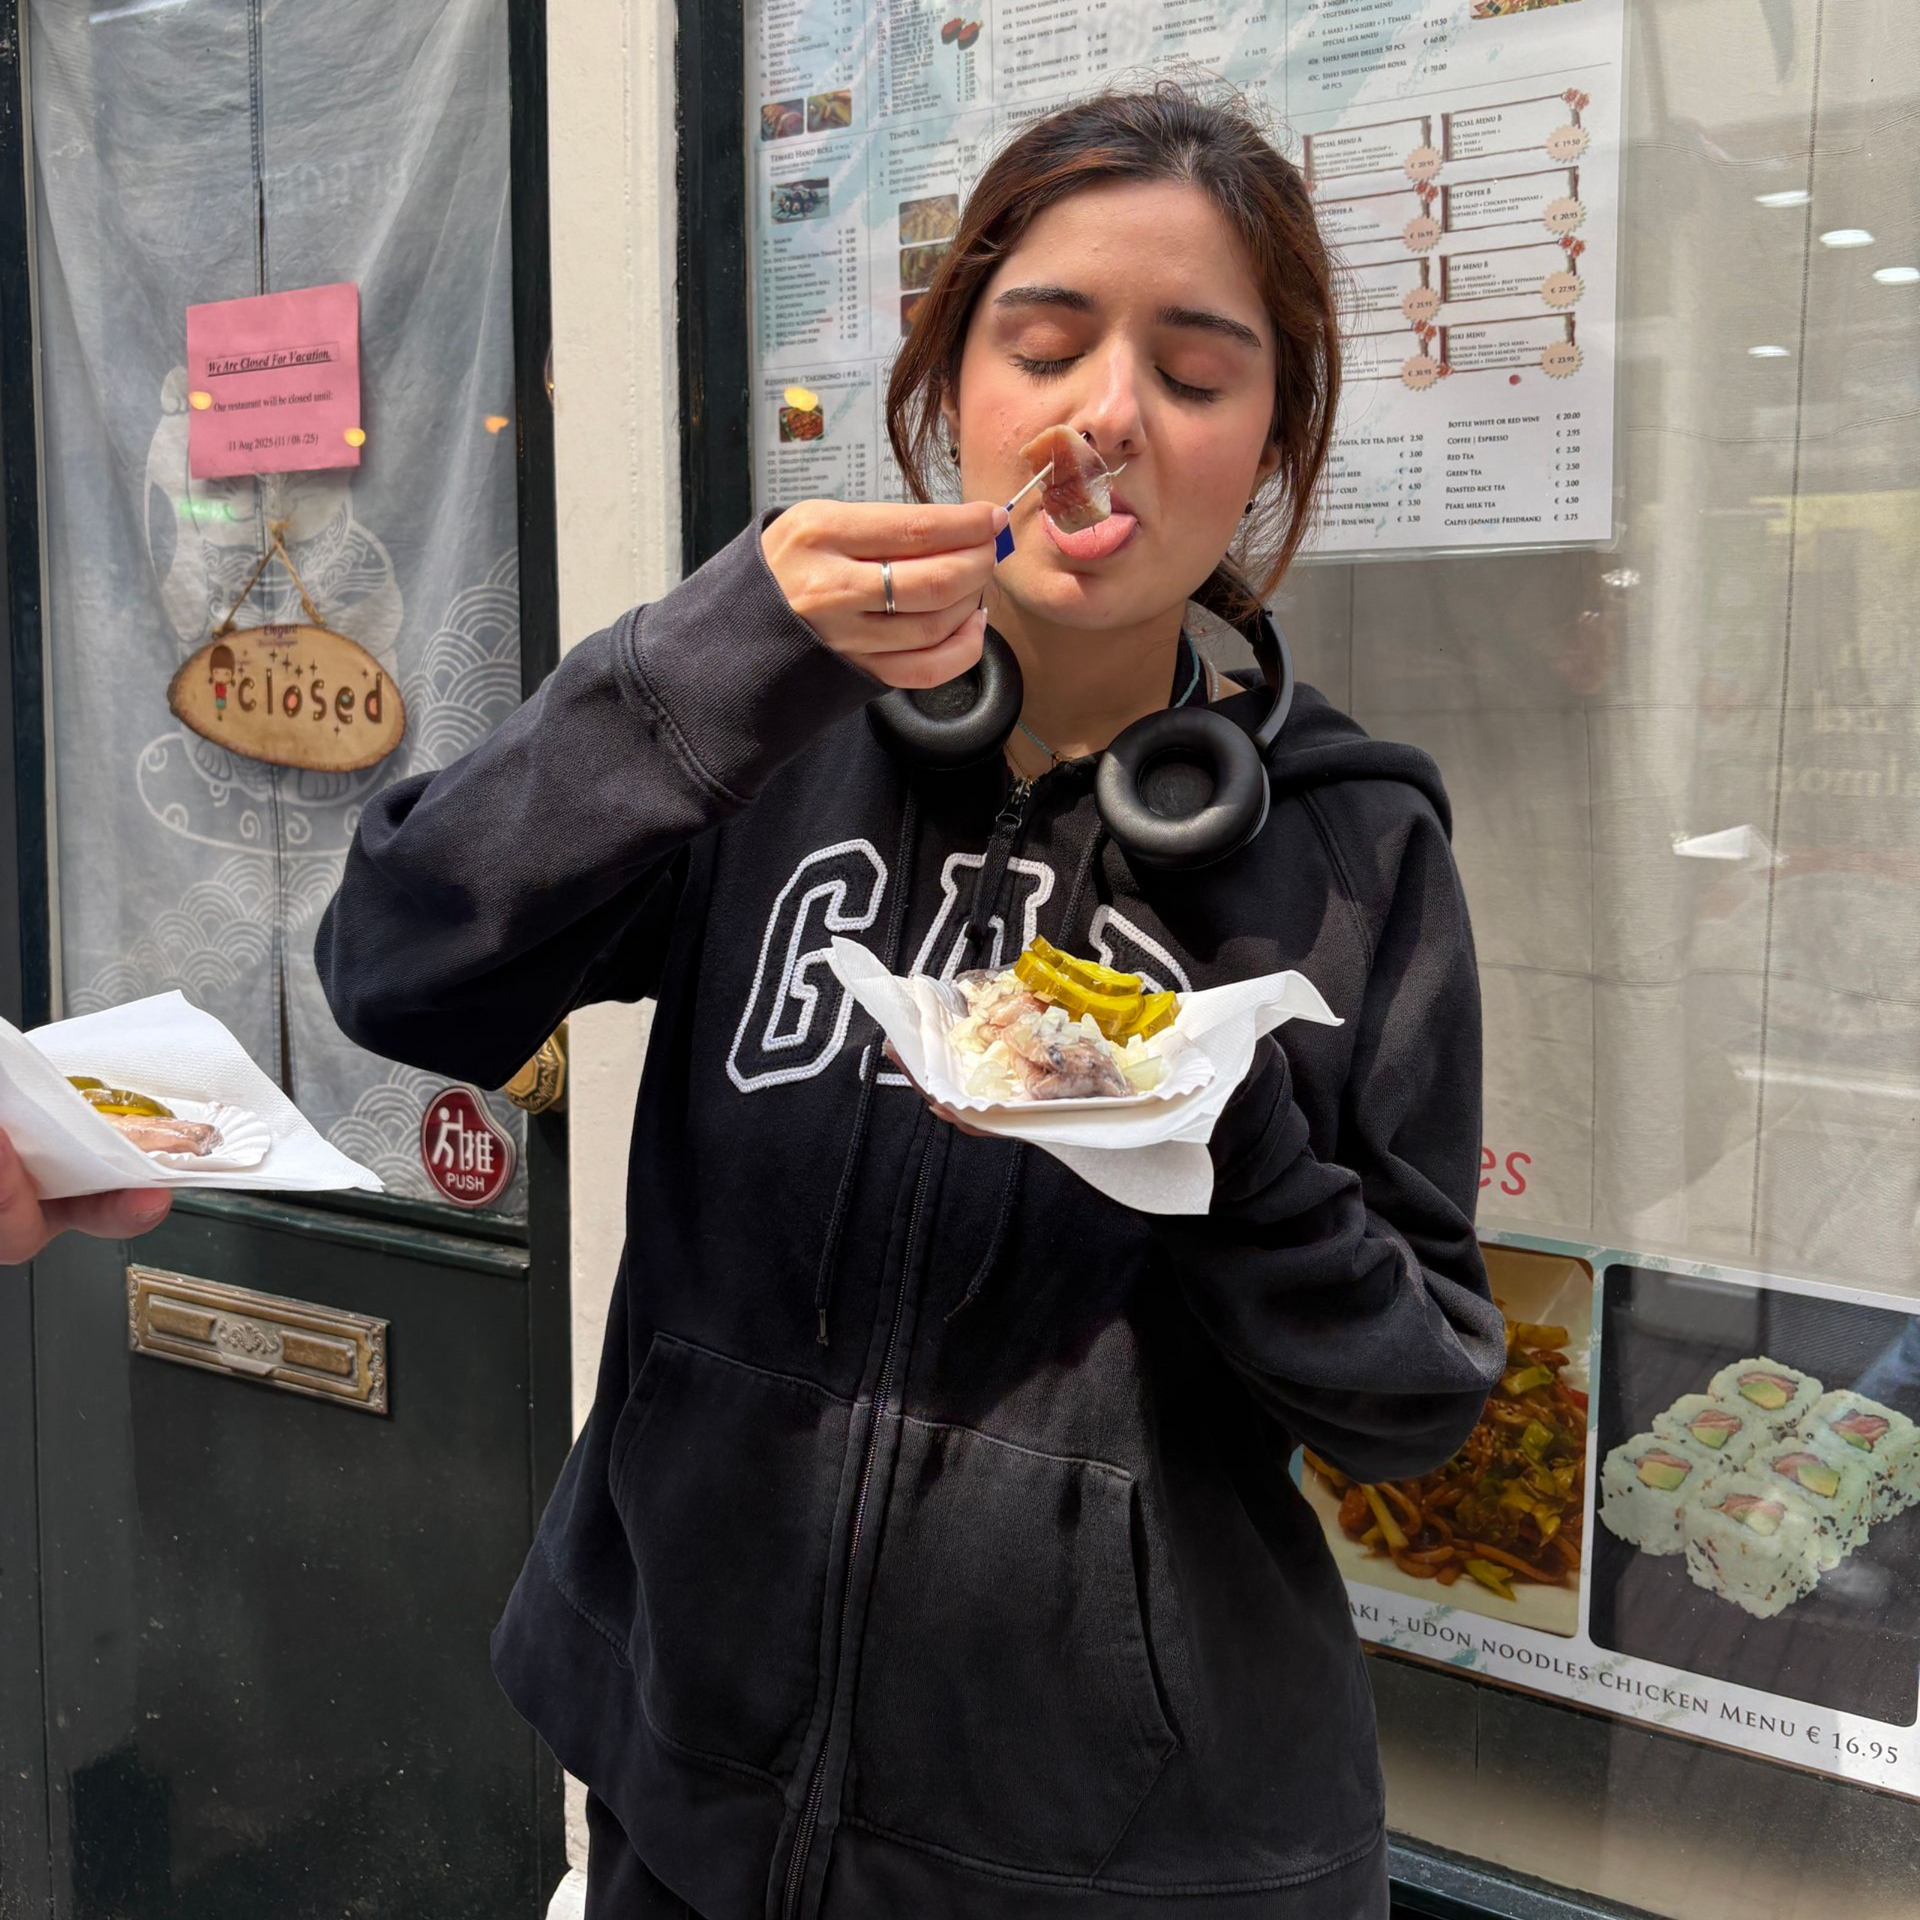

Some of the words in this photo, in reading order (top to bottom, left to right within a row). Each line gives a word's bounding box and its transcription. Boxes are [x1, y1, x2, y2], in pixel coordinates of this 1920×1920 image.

[1475, 117, 1496, 125] MENU
[1558, 285, 1576, 294] 27.95
[1466, 331, 1486, 339] MENU
[207, 361, 222, 374] We
[223, 359, 237, 372] Are
[240, 355, 269, 370] Closed
[272, 354, 286, 366] For
[288, 349, 331, 363] Vacation.
[214, 402, 226, 413] Our
[228, 399, 261, 410] restaurant
[263, 396, 277, 407] will
[278, 396, 287, 405] be
[288, 394, 312, 404] closed
[313, 391, 333, 402] until:
[1473, 419, 1495, 427] WHITE
[1563, 412, 1580, 420] 20.00
[1410, 434, 1423, 442] 2.50
[1447, 437, 1471, 445] COFFEE
[1477, 435, 1509, 443] ESPRESSO
[1566, 429, 1580, 437] 2.95
[229, 440, 236, 451] 11
[239, 439, 253, 452] Aug
[255, 437, 273, 449] 2025
[1566, 446, 1580, 454] 2.50
[1409, 450, 1423, 458] 3.00
[1446, 469, 1468, 477] GREEN
[1555, 480, 1559, 488] €
[1565, 479, 1580, 487] 3.00
[1565, 496, 1579, 504] 4.50
[1407, 515, 1420, 523] 3.50
[1444, 518, 1467, 526] CALPIS
[1468, 518, 1501, 526] (JAPANESE
[1502, 516, 1541, 524] FRISDRANK)
[1564, 513, 1578, 521] 3.75
[238, 668, 383, 725] closed
[726, 838, 1193, 1093] GA
[446, 1173, 485, 1191] PUSH
[1407, 1617, 1472, 1647] UDON
[1481, 1638, 1589, 1680] NOODLES
[1599, 1671, 1709, 1714] CHICKEN
[1719, 1703, 1796, 1737] MENU
[1806, 1725, 1821, 1744] €
[1832, 1732, 1898, 1764] 16.95
